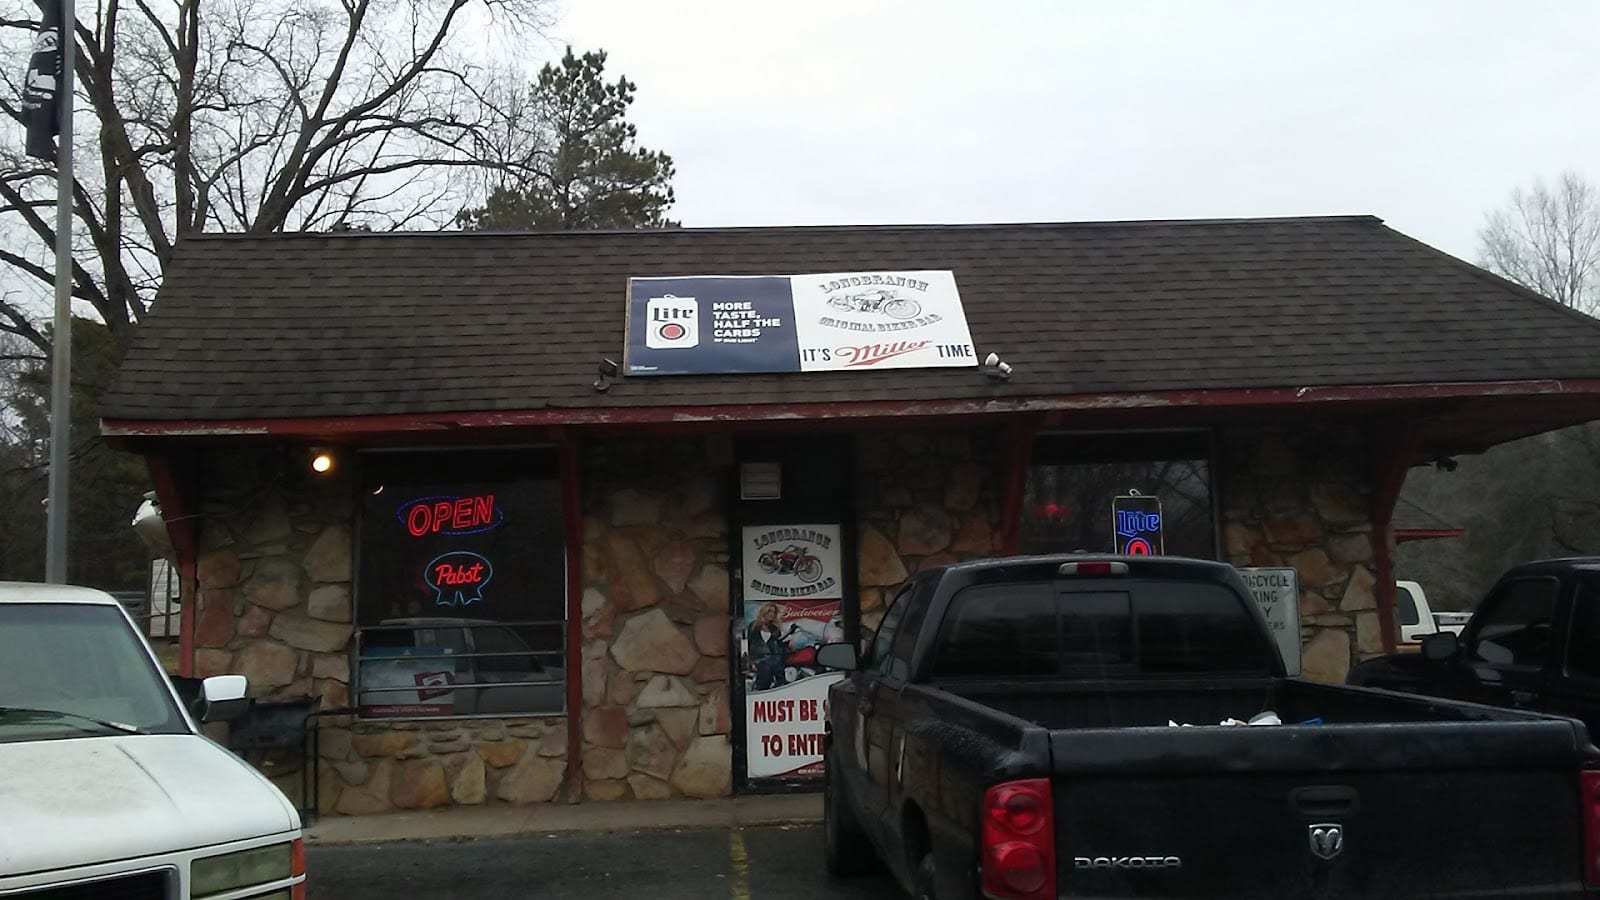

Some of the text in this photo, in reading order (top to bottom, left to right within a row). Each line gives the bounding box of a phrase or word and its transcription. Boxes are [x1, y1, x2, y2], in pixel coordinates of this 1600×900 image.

[819, 275, 929, 294] LONGBRANCH
[652, 307, 694, 322] Lite
[712, 302, 752, 311] MORE
[712, 311, 761, 320] TASTE,
[714, 319, 781, 329] HALF THE
[818, 313, 943, 332] ORIGINAL BIKER BAR
[714, 329, 761, 338] CARBS
[803, 339, 973, 366] IT'S Miller TIME
[407, 495, 495, 537] OPEN
[1117, 510, 1160, 537] Lite
[754, 528, 832, 550] LONGBRANCH
[435, 562, 484, 586] Pabst
[750, 577, 836, 597] ORIGINAL BIKER BAR
[782, 606, 840, 619] Budweiser
[753, 700, 795, 723] MUST
[799, 699, 818, 721] BE
[761, 734, 783, 757] TO
[1074, 857, 1181, 868] DAKOTA
